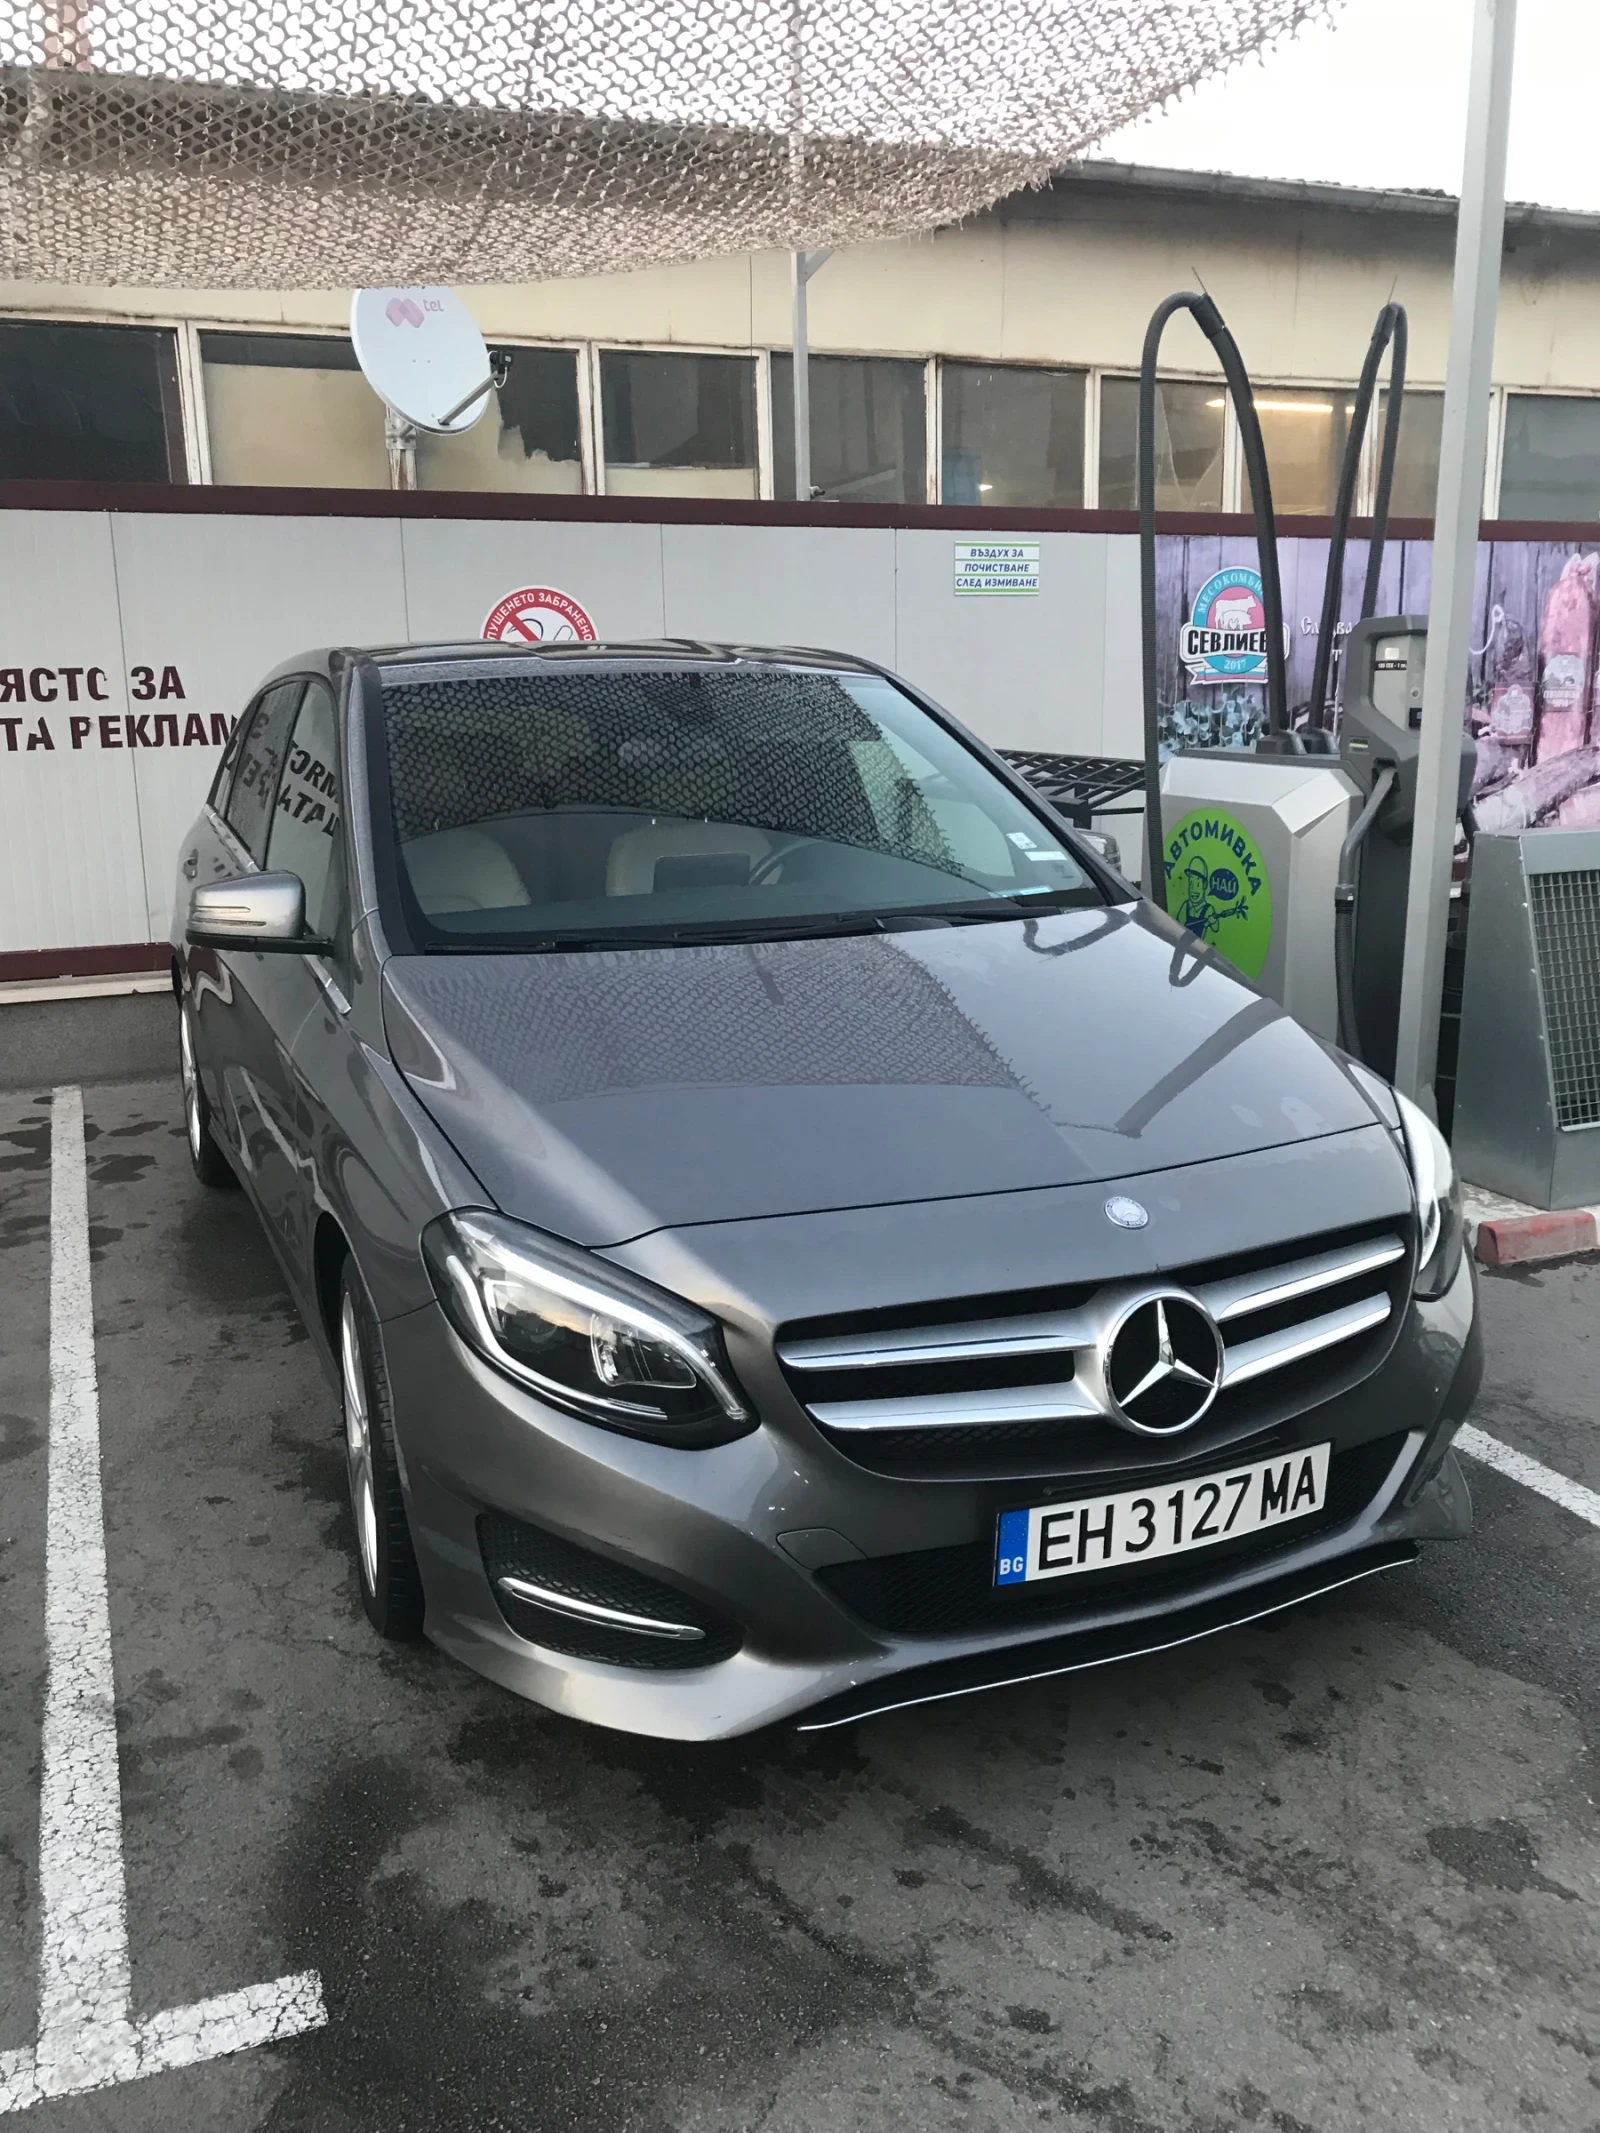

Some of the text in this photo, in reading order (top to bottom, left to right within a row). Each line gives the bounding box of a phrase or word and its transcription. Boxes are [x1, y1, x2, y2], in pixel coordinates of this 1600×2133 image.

[423, 299, 444, 312] tel
[970, 548, 1024, 558] ВЪЗДУХ ЗА
[964, 563, 1030, 572] ПОЧИСТВАНЕ
[956, 578, 1037, 588] СЛЕД ИЗМИВАНЕ
[1198, 572, 1264, 613] МЕСОКОМБИ
[487, 592, 593, 640] ПУШЕНЕТО ЗАБРАНЕНО
[1223, 659, 1247, 671] 2017
[131, 666, 186, 700] ЗА
[0, 716, 56, 752] ТА
[1164, 819, 1262, 896] АВТОМИВКА
[1212, 877, 1236, 894] НАЙ
[1038, 1455, 1317, 1570] EH 3127 MA
[1000, 1556, 1024, 1576] BG
